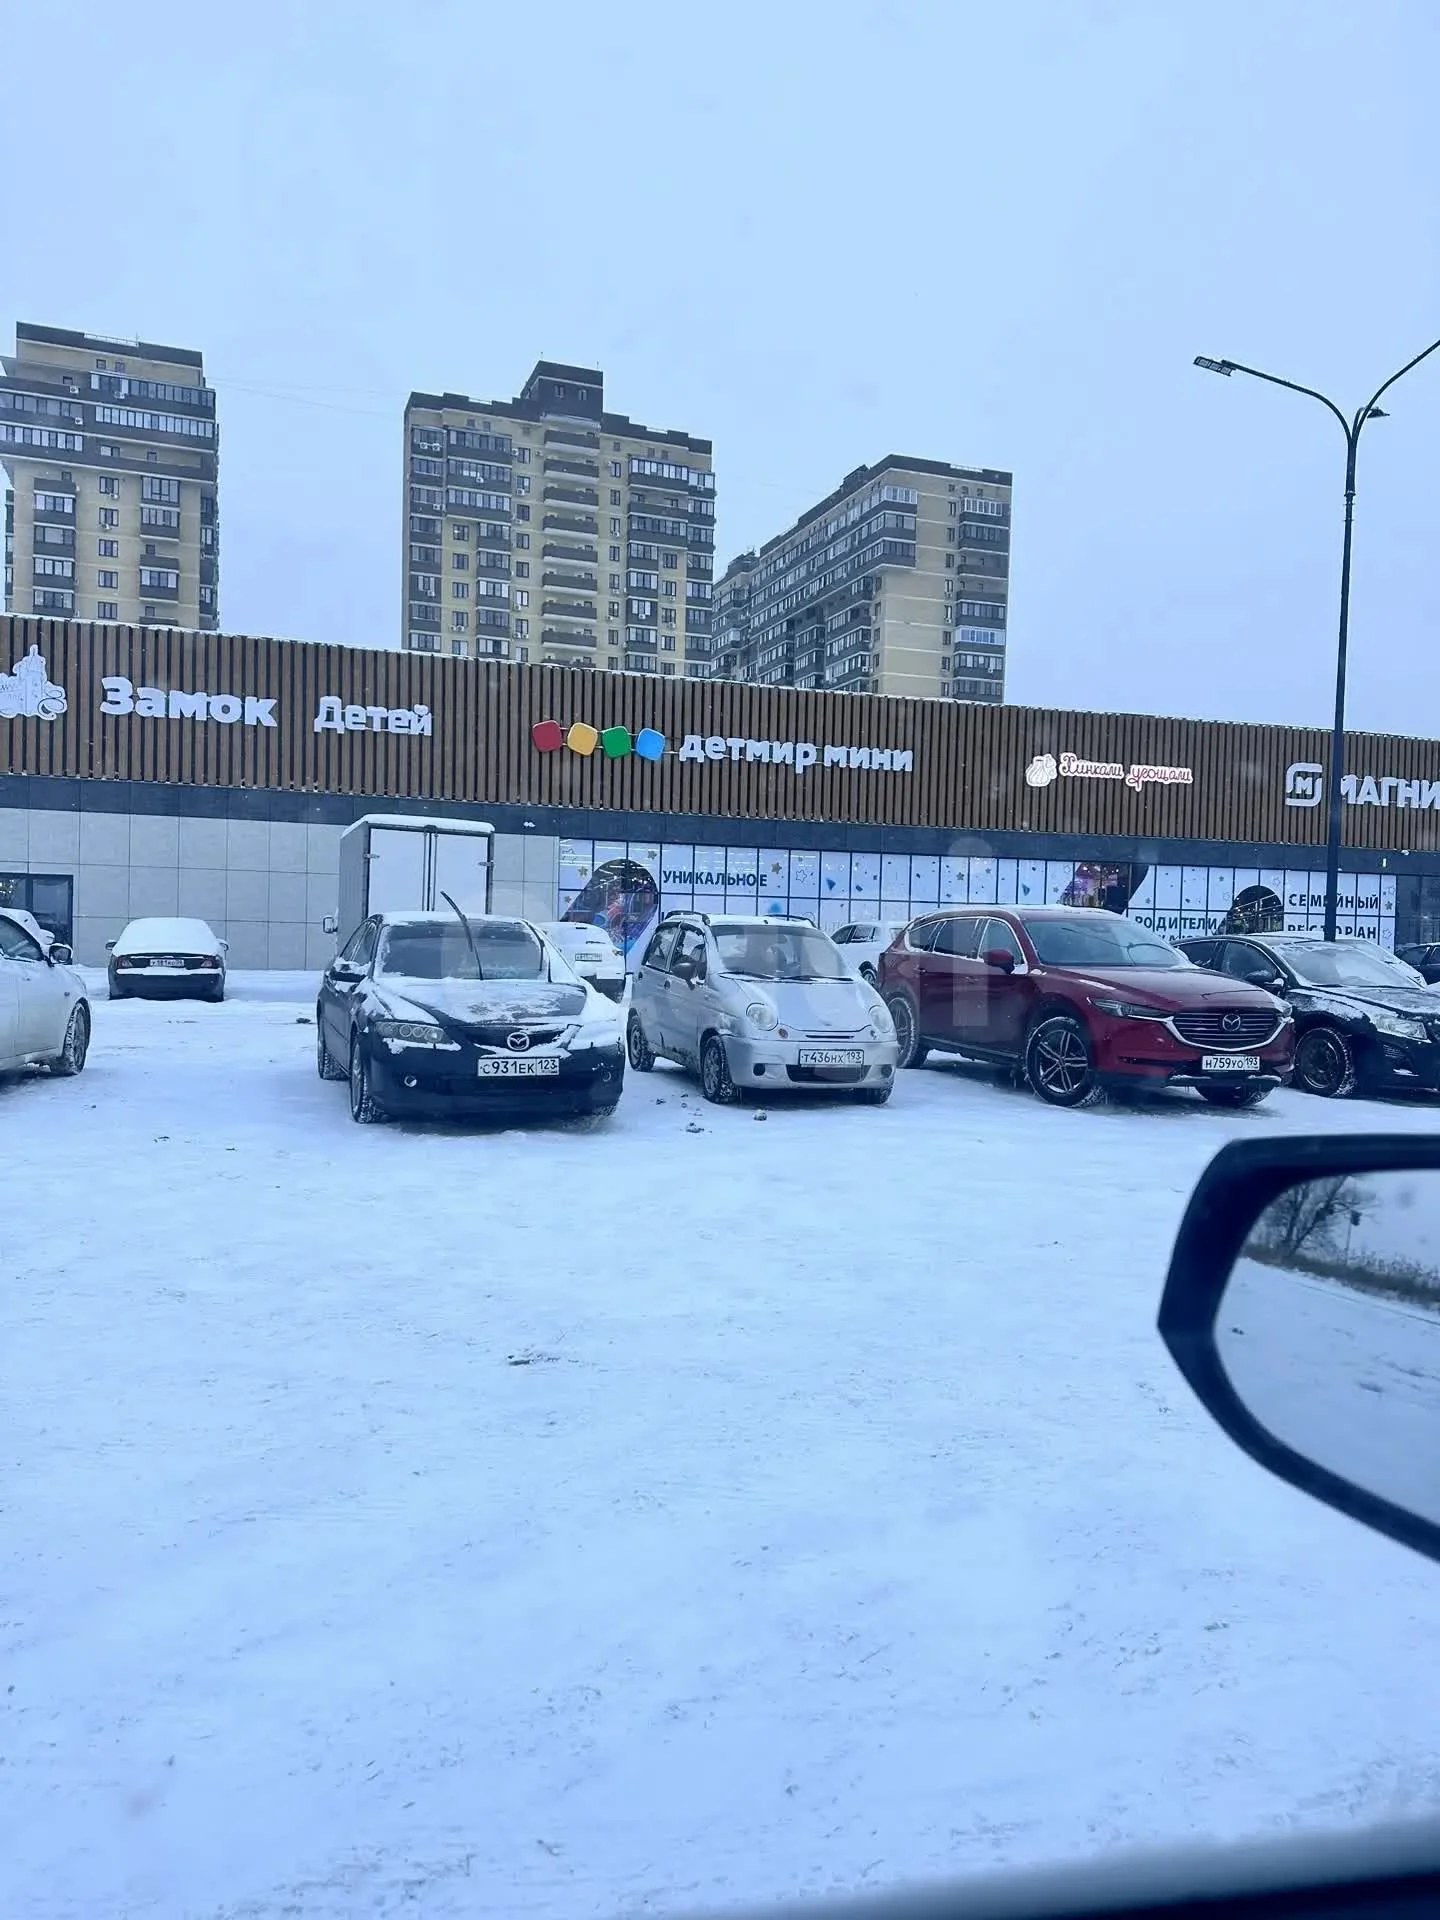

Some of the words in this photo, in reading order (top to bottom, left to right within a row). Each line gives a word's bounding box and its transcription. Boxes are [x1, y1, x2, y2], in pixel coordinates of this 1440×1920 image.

[100, 676, 278, 728] Замок
[313, 695, 433, 736] Детей
[678, 734, 817, 774] детмир
[823, 744, 913, 772] мини
[1060, 753, 1123, 778] Хинкали
[1126, 765, 1192, 791] угощали
[663, 870, 768, 887] УНИКАЛЬНОЕ
[1288, 893, 1378, 909] СЕМЙНЫЙ
[1135, 916, 1217, 932] РОДИТЕЛИ
